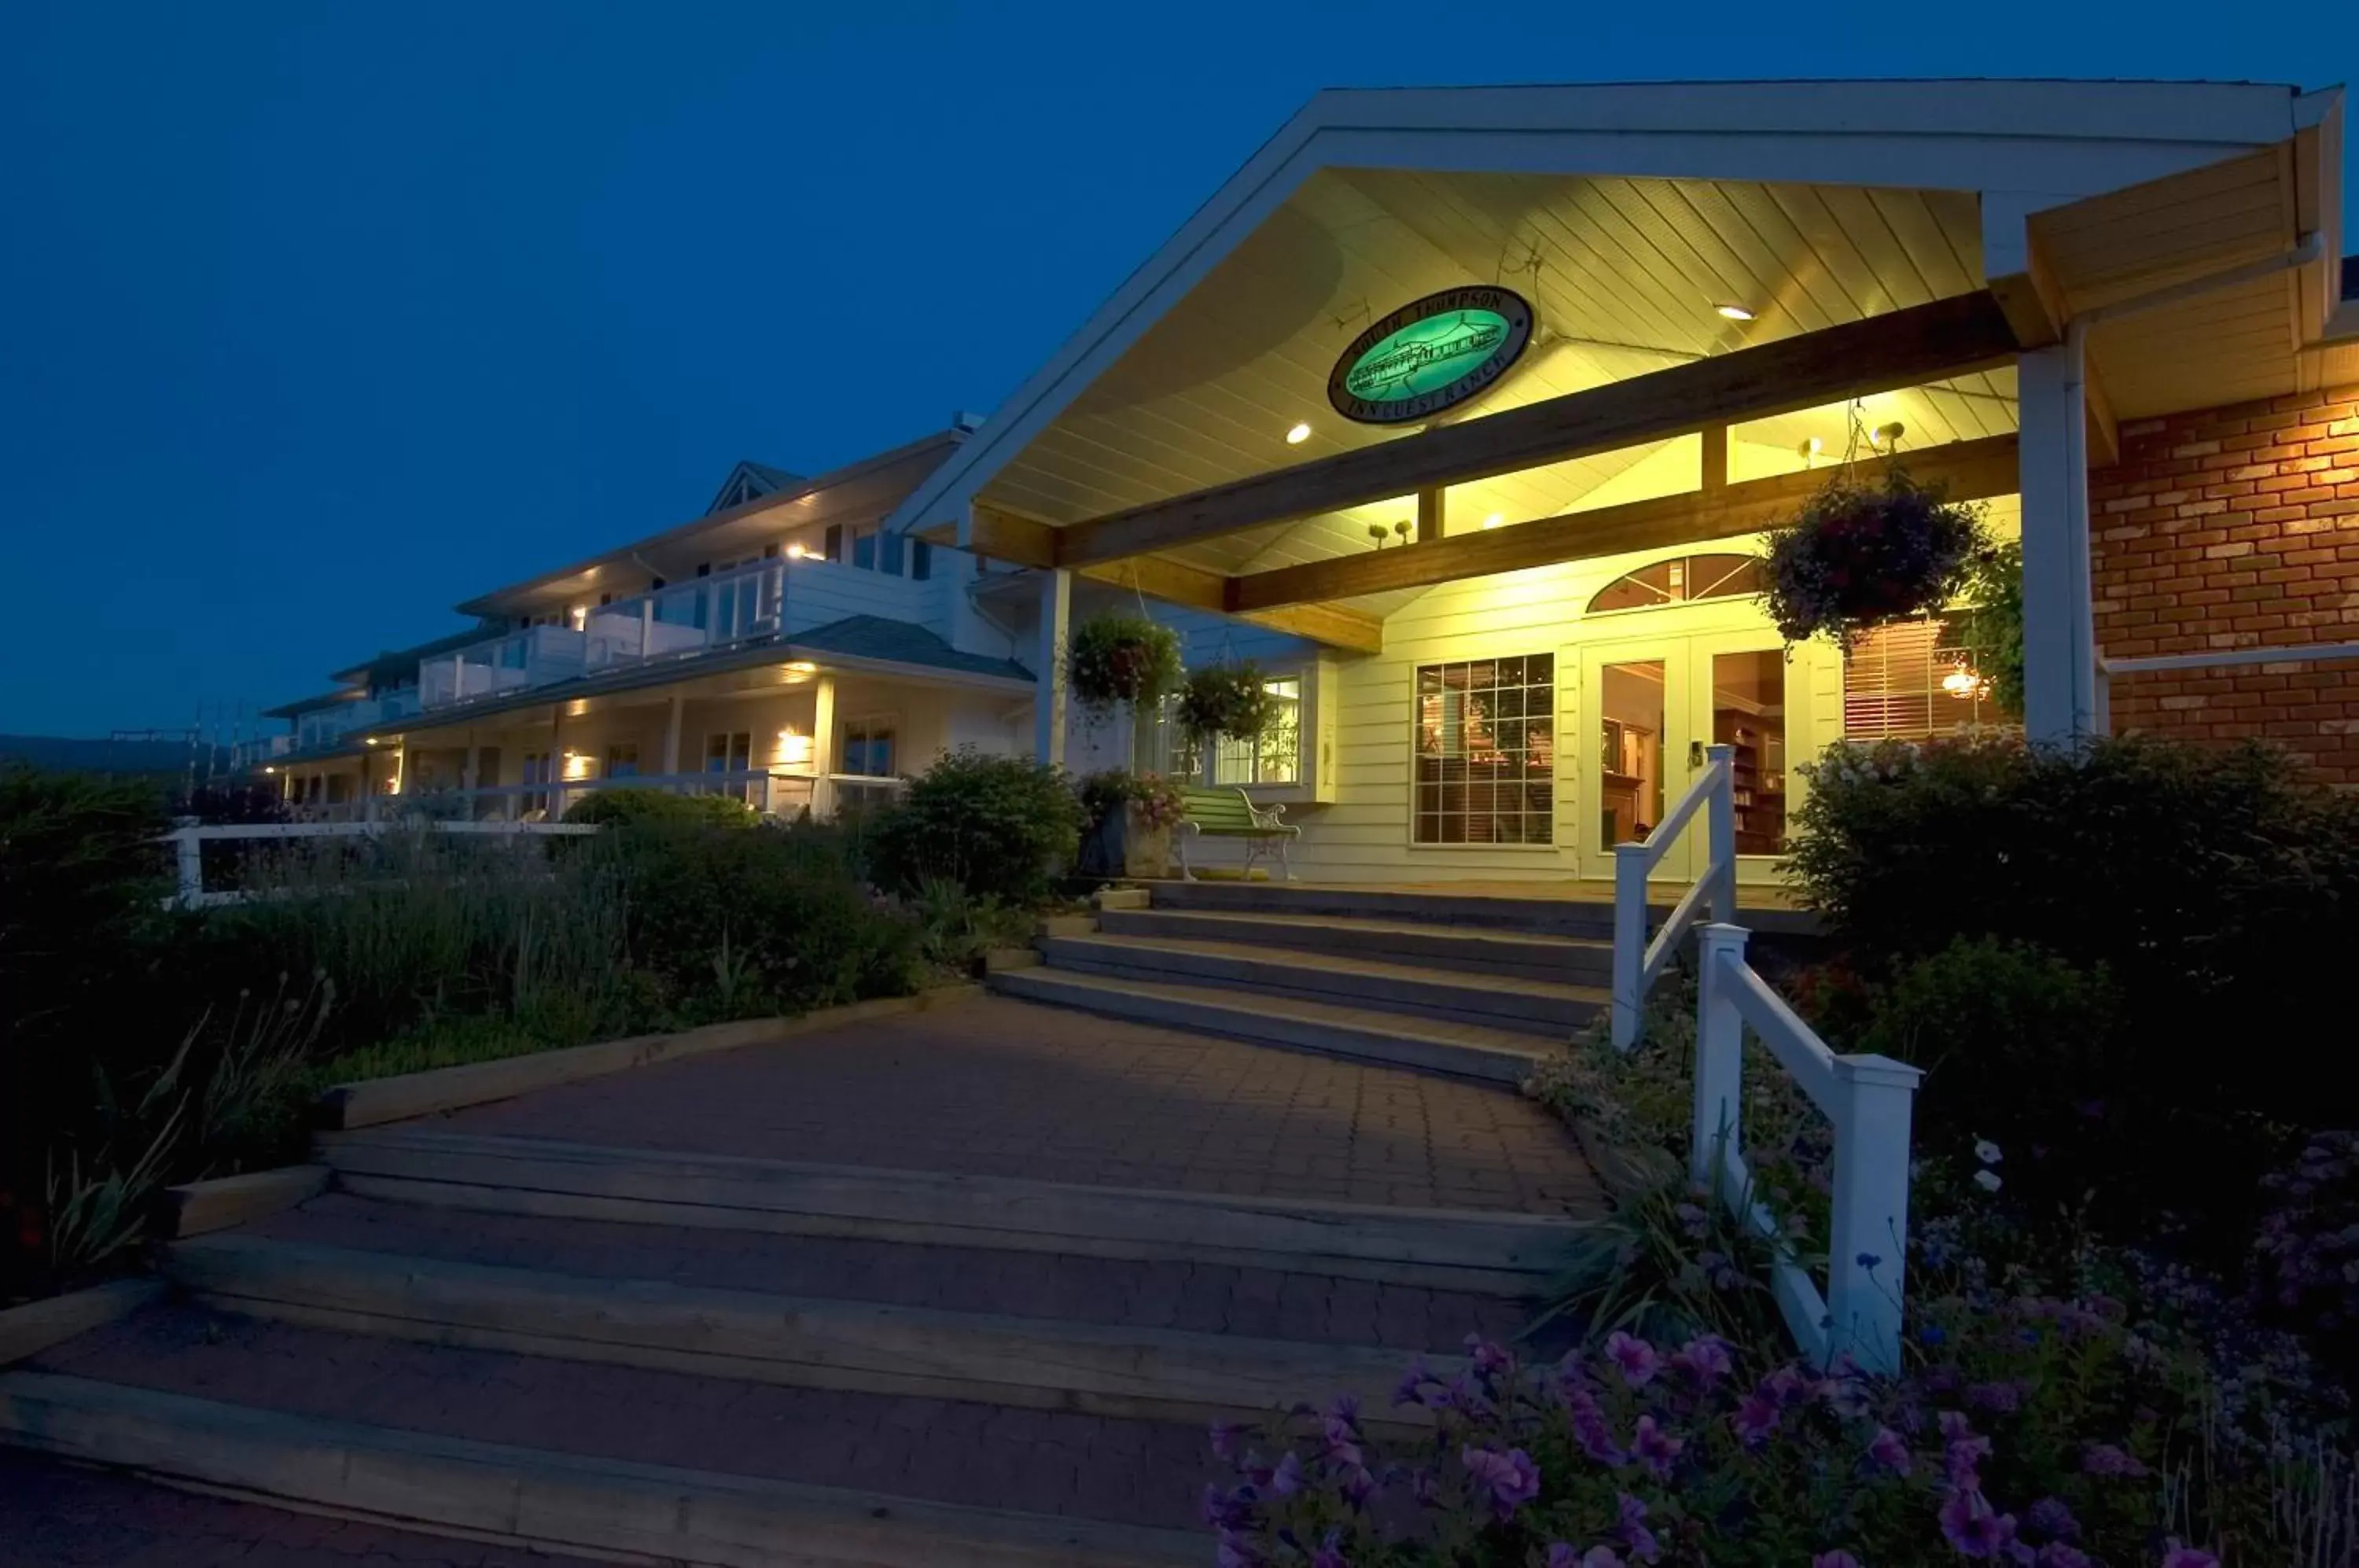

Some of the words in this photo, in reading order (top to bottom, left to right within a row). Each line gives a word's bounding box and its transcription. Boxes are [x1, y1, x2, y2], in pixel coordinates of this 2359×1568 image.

[1415, 291, 1502, 320] THOMPSON
[1382, 394, 1438, 418] GUEST
[1444, 355, 1507, 402] RANCH
